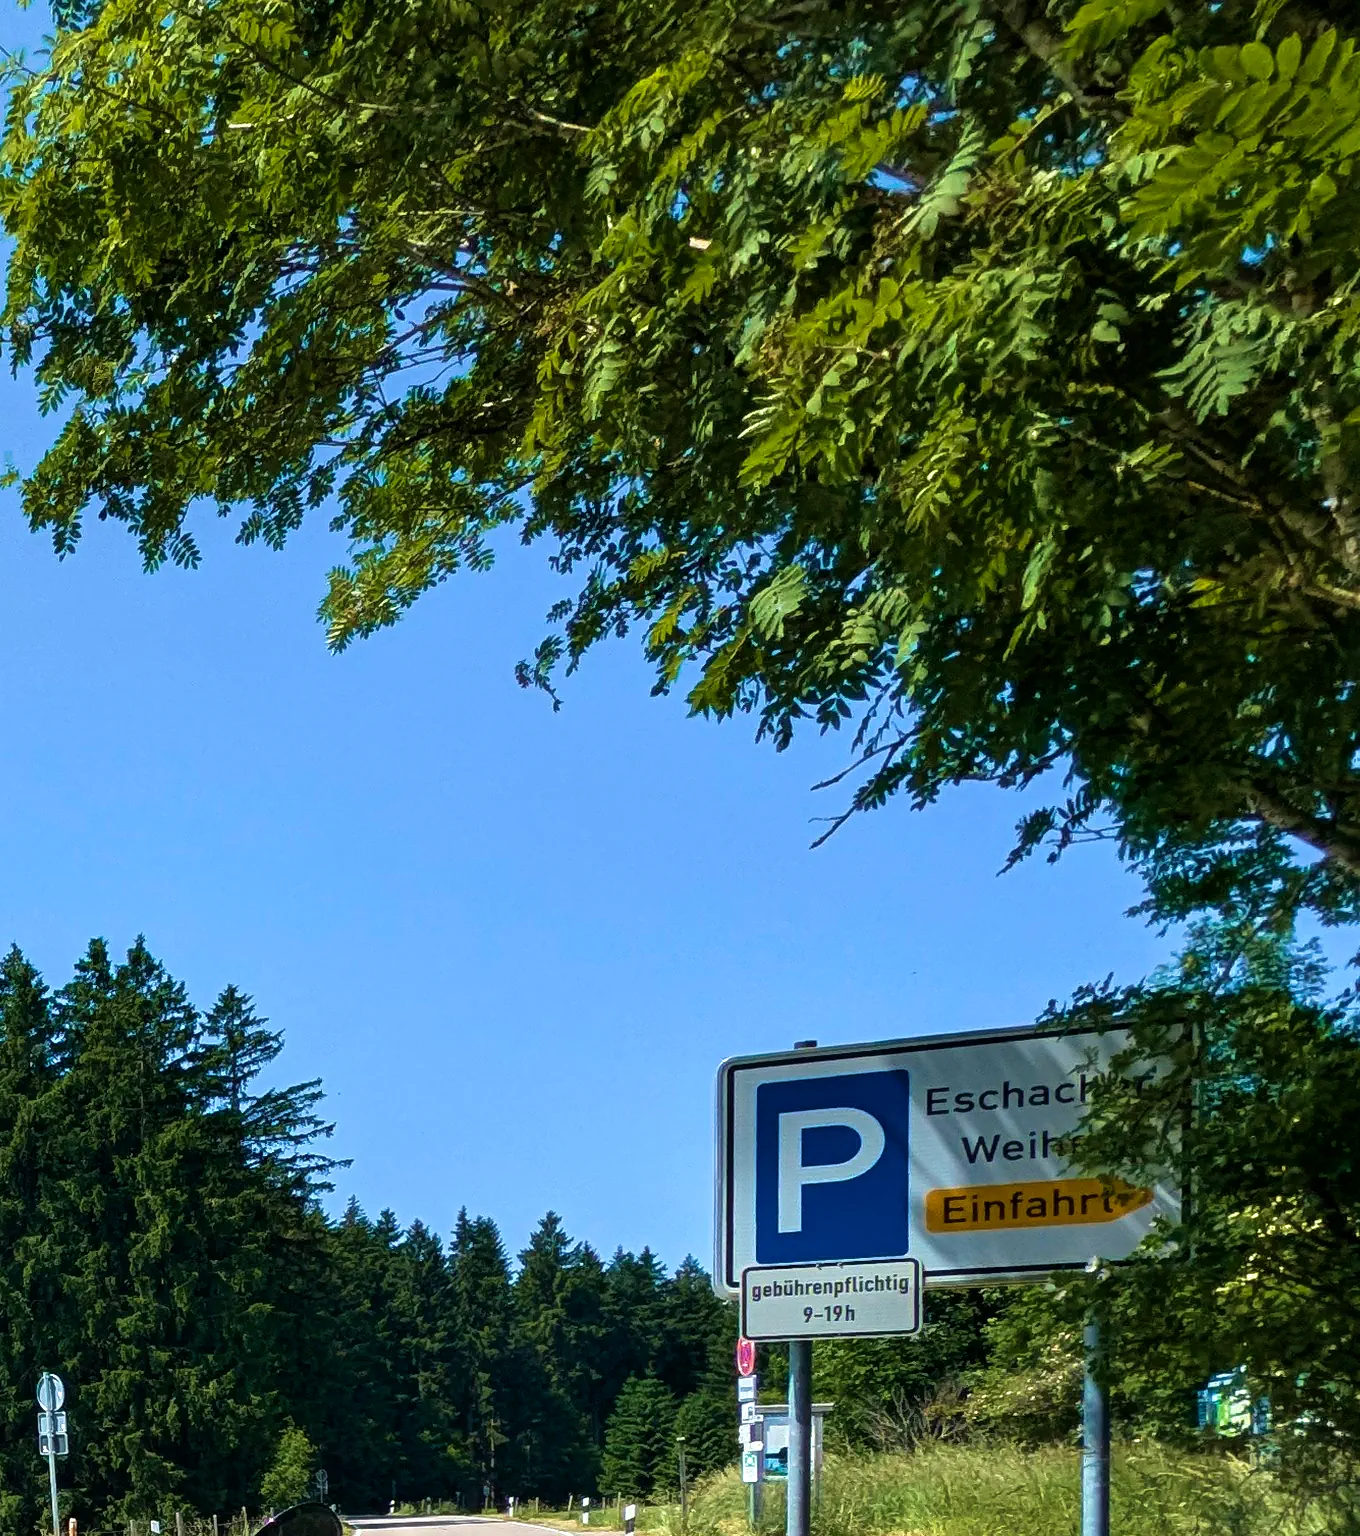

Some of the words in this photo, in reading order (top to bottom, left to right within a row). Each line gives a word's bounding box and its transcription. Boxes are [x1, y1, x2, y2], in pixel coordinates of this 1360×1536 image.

[777, 1106, 885, 1233] P
[943, 1188, 1114, 1224] Einfahrt
[751, 1273, 910, 1302] gebührenpflichtig
